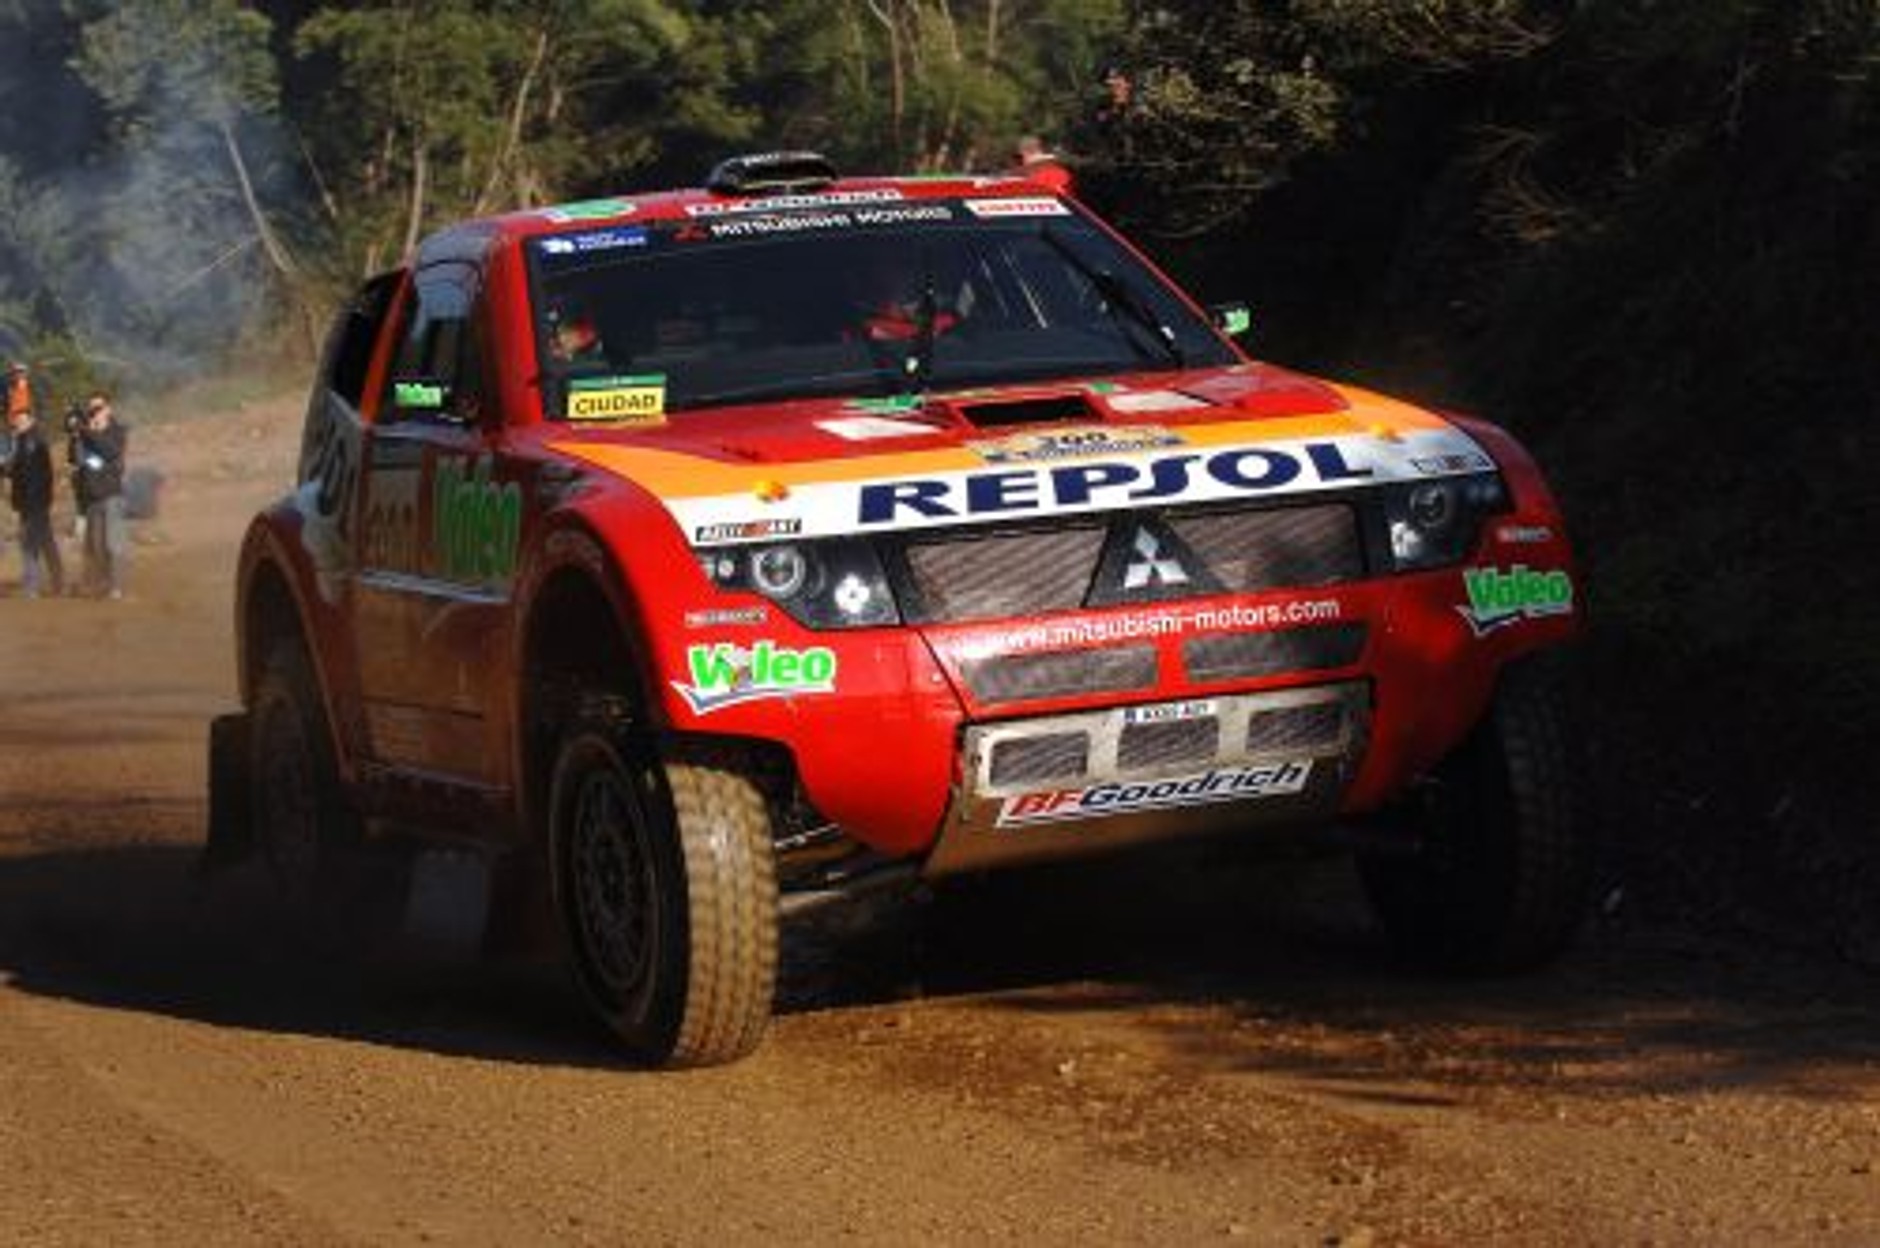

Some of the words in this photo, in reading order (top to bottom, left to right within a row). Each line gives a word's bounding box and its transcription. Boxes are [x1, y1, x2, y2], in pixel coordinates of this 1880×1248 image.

[575, 394, 656, 415] CIUDAD
[858, 443, 1374, 525] REPSOL
[1464, 566, 1573, 612] Valeo
